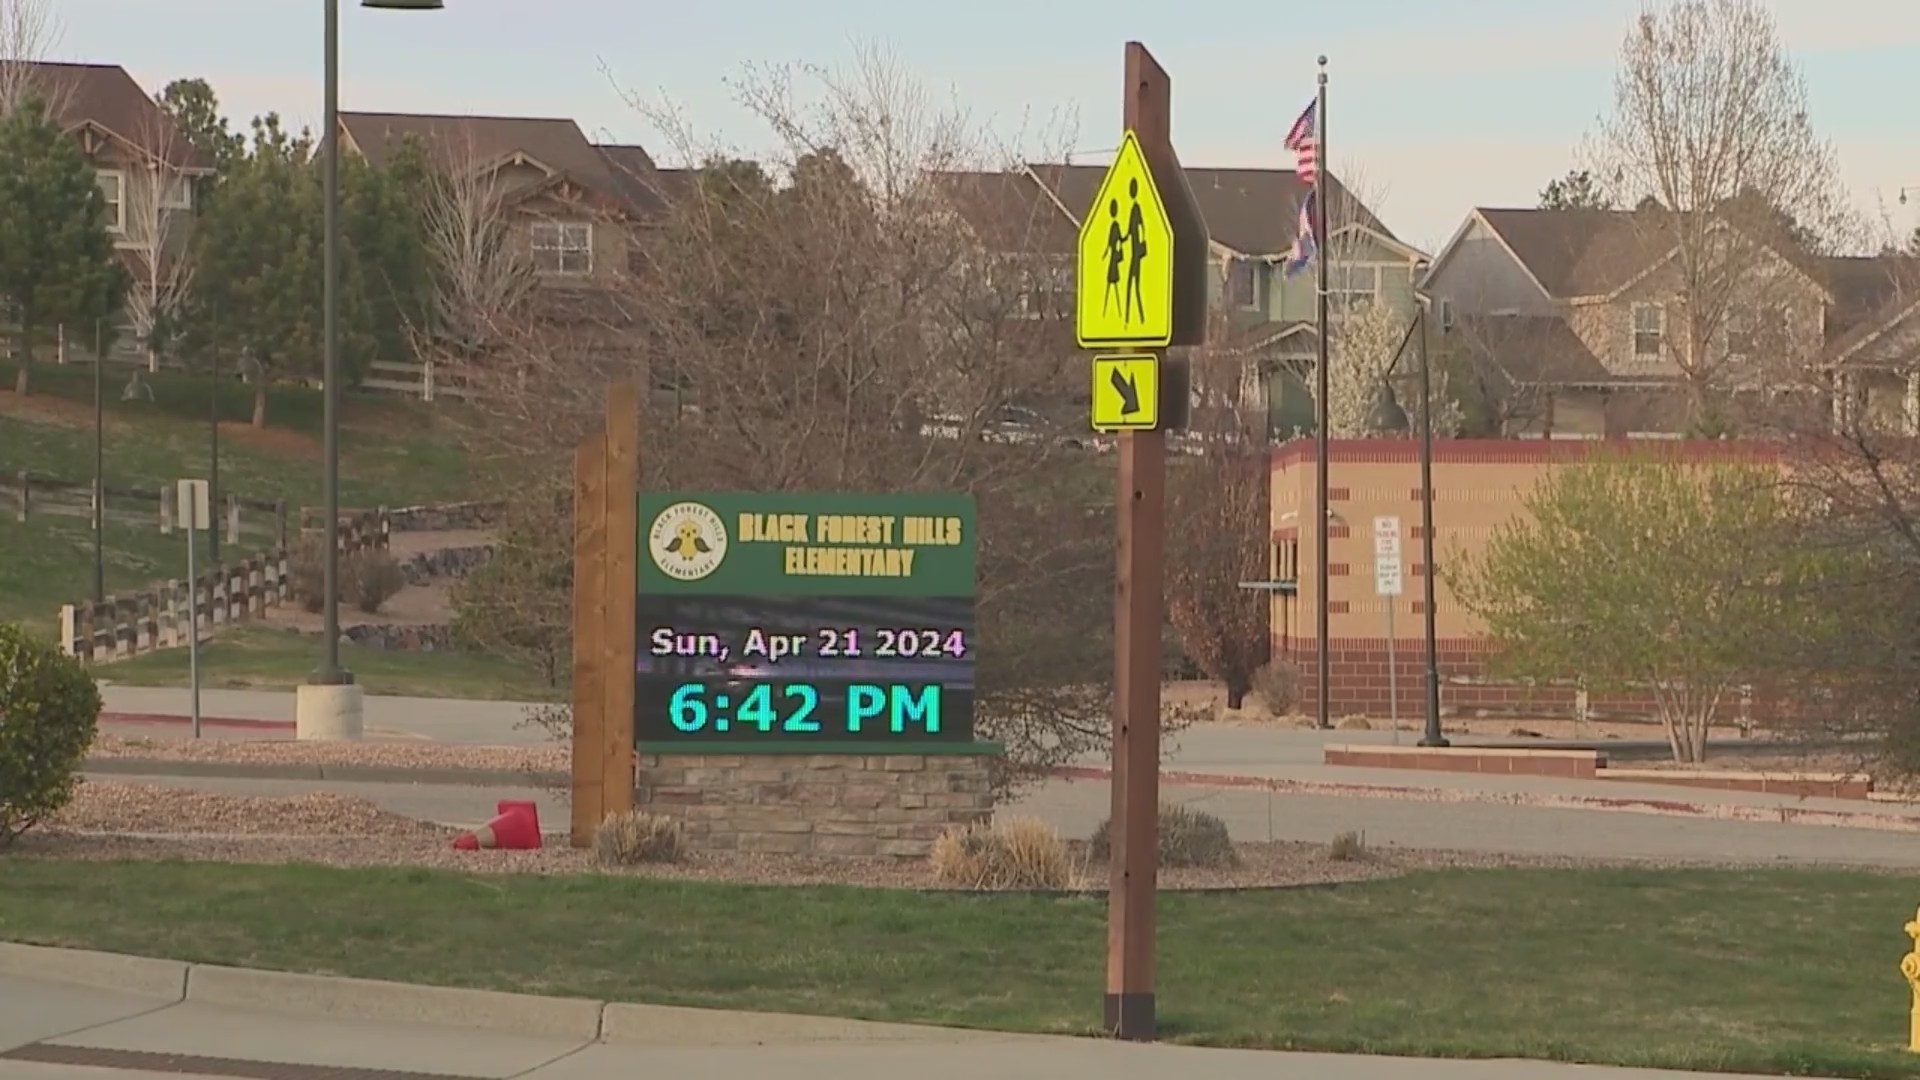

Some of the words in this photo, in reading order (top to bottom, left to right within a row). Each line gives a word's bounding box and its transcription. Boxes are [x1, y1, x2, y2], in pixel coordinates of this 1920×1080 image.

[738, 513, 809, 542] BLACK
[817, 515, 895, 544] FOREST
[903, 516, 961, 545] HILLS
[660, 558, 715, 577] ELEMENTARY
[785, 547, 915, 577] ELEMENTARY
[651, 628, 729, 661] Sun,
[743, 629, 807, 662] Apr
[819, 629, 861, 656] 21
[875, 630, 966, 657] 2024
[670, 684, 821, 733] 6:42
[848, 684, 942, 733] PM
